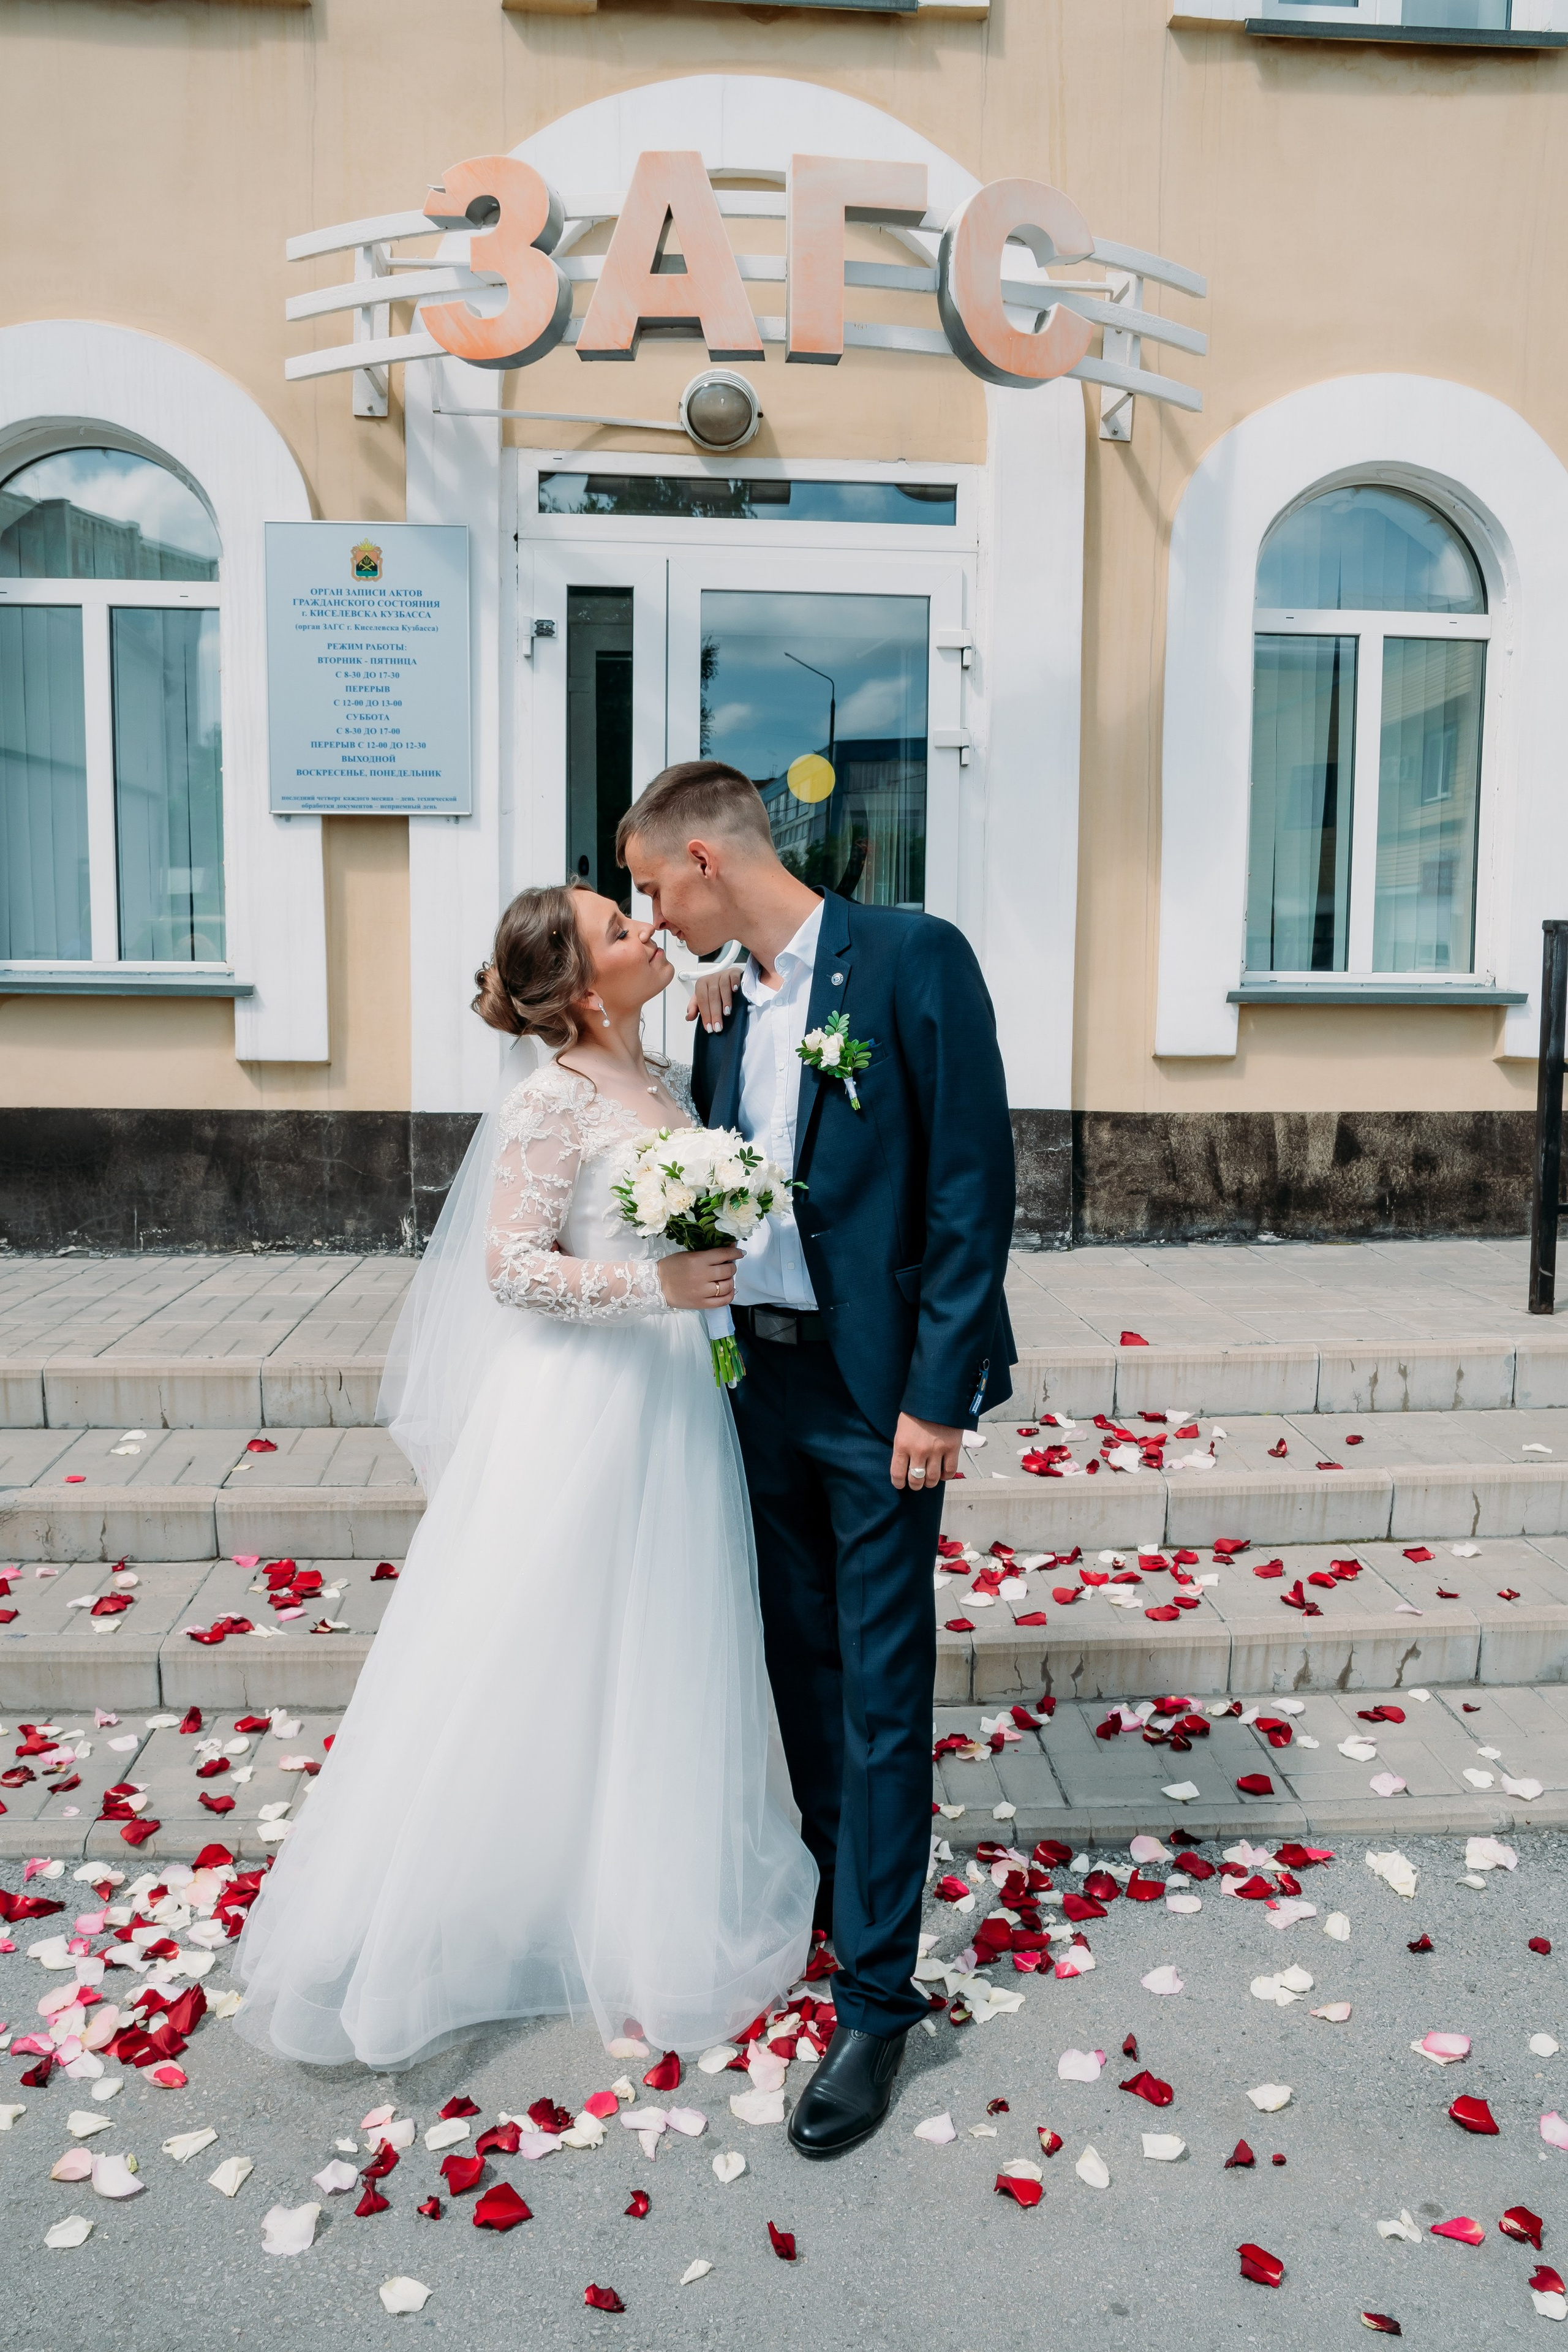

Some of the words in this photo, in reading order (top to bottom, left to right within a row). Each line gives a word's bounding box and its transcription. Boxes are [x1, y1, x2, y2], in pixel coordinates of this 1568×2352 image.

[420, 151, 1095, 383] ЗАГС
[293, 598, 375, 607] ГРАЖДАНСКОГО
[377, 600, 440, 608] СОСТОЯНИЯ
[310, 609, 378, 618] КИСЕЛЕВСКА
[380, 610, 432, 619] КУЗБАССА
[401, 624, 439, 633] Кузбасса)
[370, 657, 417, 666] ПЯТНИЦА
[341, 754, 396, 763] ВЫХОДНОЙ
[296, 769, 368, 777] ВОСКРЕСЕНЬЕ,
[369, 769, 442, 778] ПОНЕДЕЛЬНИК
